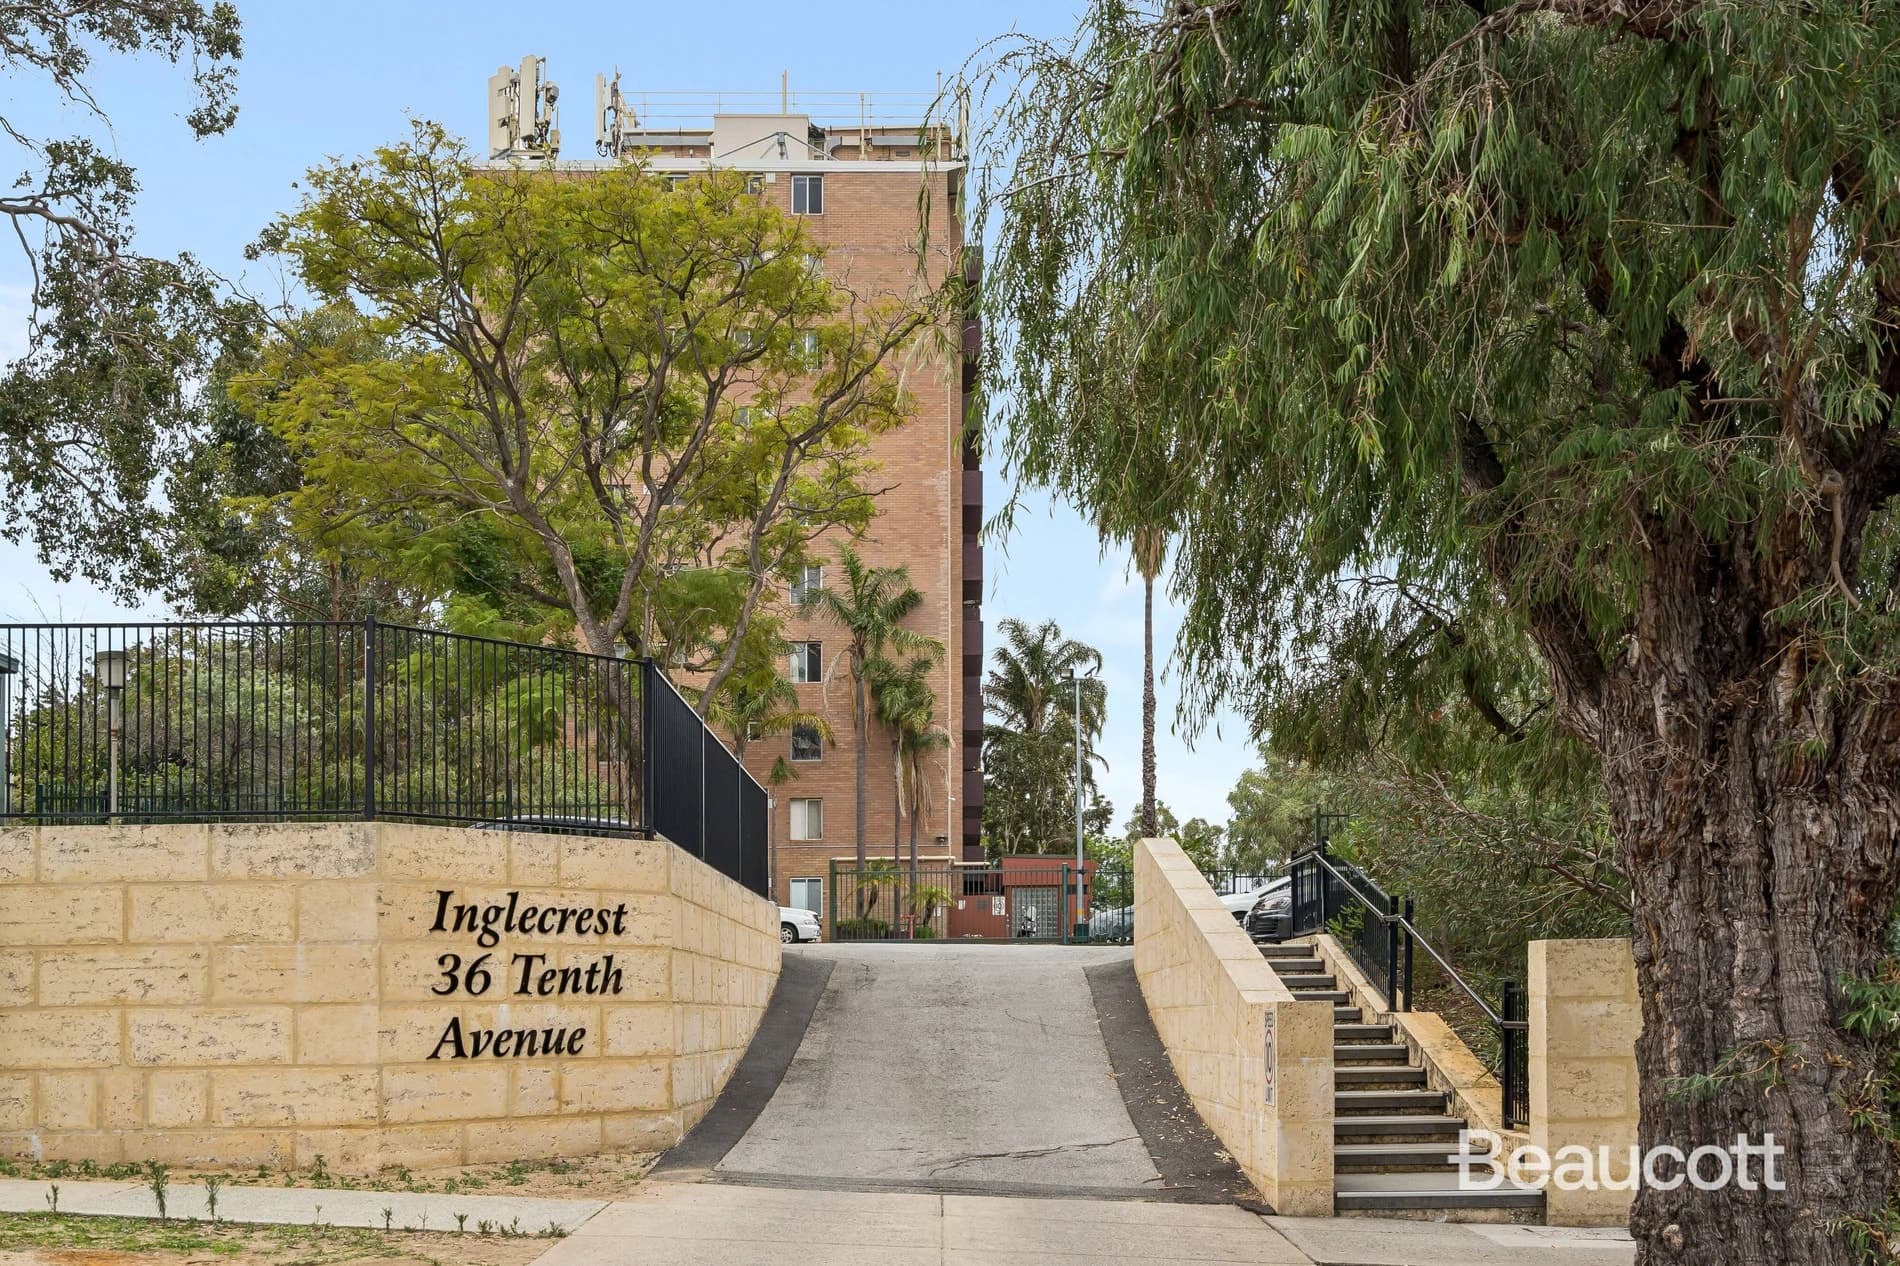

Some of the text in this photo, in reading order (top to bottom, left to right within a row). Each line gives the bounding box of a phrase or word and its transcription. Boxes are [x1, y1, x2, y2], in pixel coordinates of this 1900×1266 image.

[428, 889, 628, 948] Inglecrest
[431, 952, 623, 996] 36 Tenth
[425, 1016, 586, 1060] Avenue
